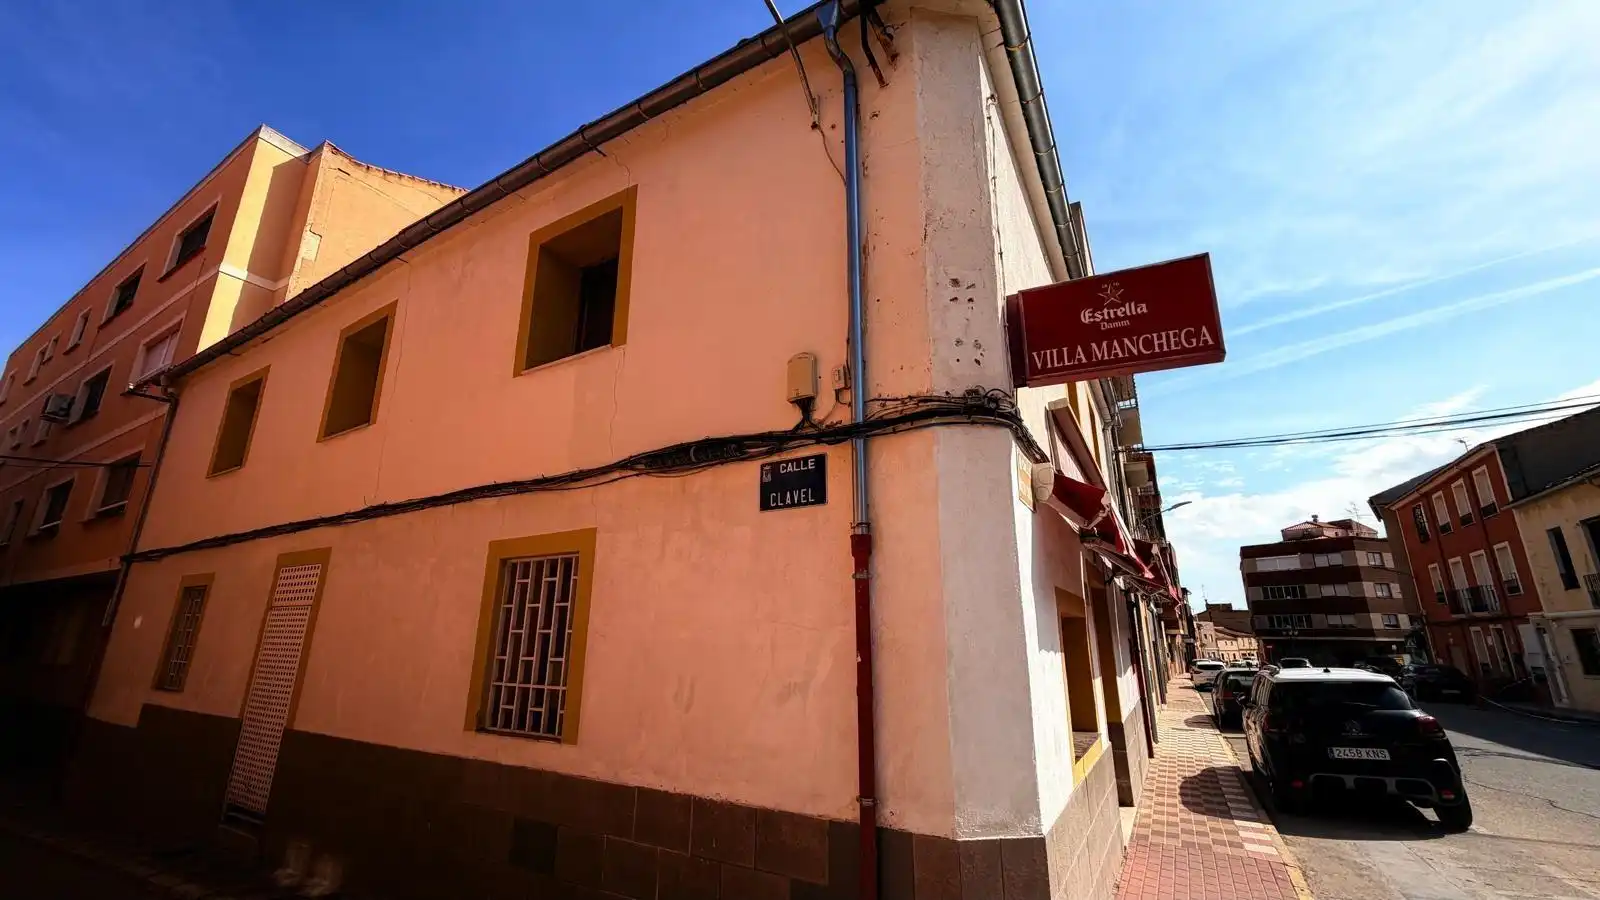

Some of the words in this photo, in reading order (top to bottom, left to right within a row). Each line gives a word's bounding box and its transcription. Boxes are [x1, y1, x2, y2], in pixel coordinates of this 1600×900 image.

[1080, 301, 1148, 324] Estrella
[1100, 319, 1130, 331] Damm
[1032, 345, 1088, 370] VILLA
[1090, 325, 1215, 362] MANCHEGA
[779, 458, 816, 474] CALLE
[770, 488, 815, 507] CLAVEL
[1335, 748, 1362, 758] 2458
[1365, 749, 1387, 759] KNS
